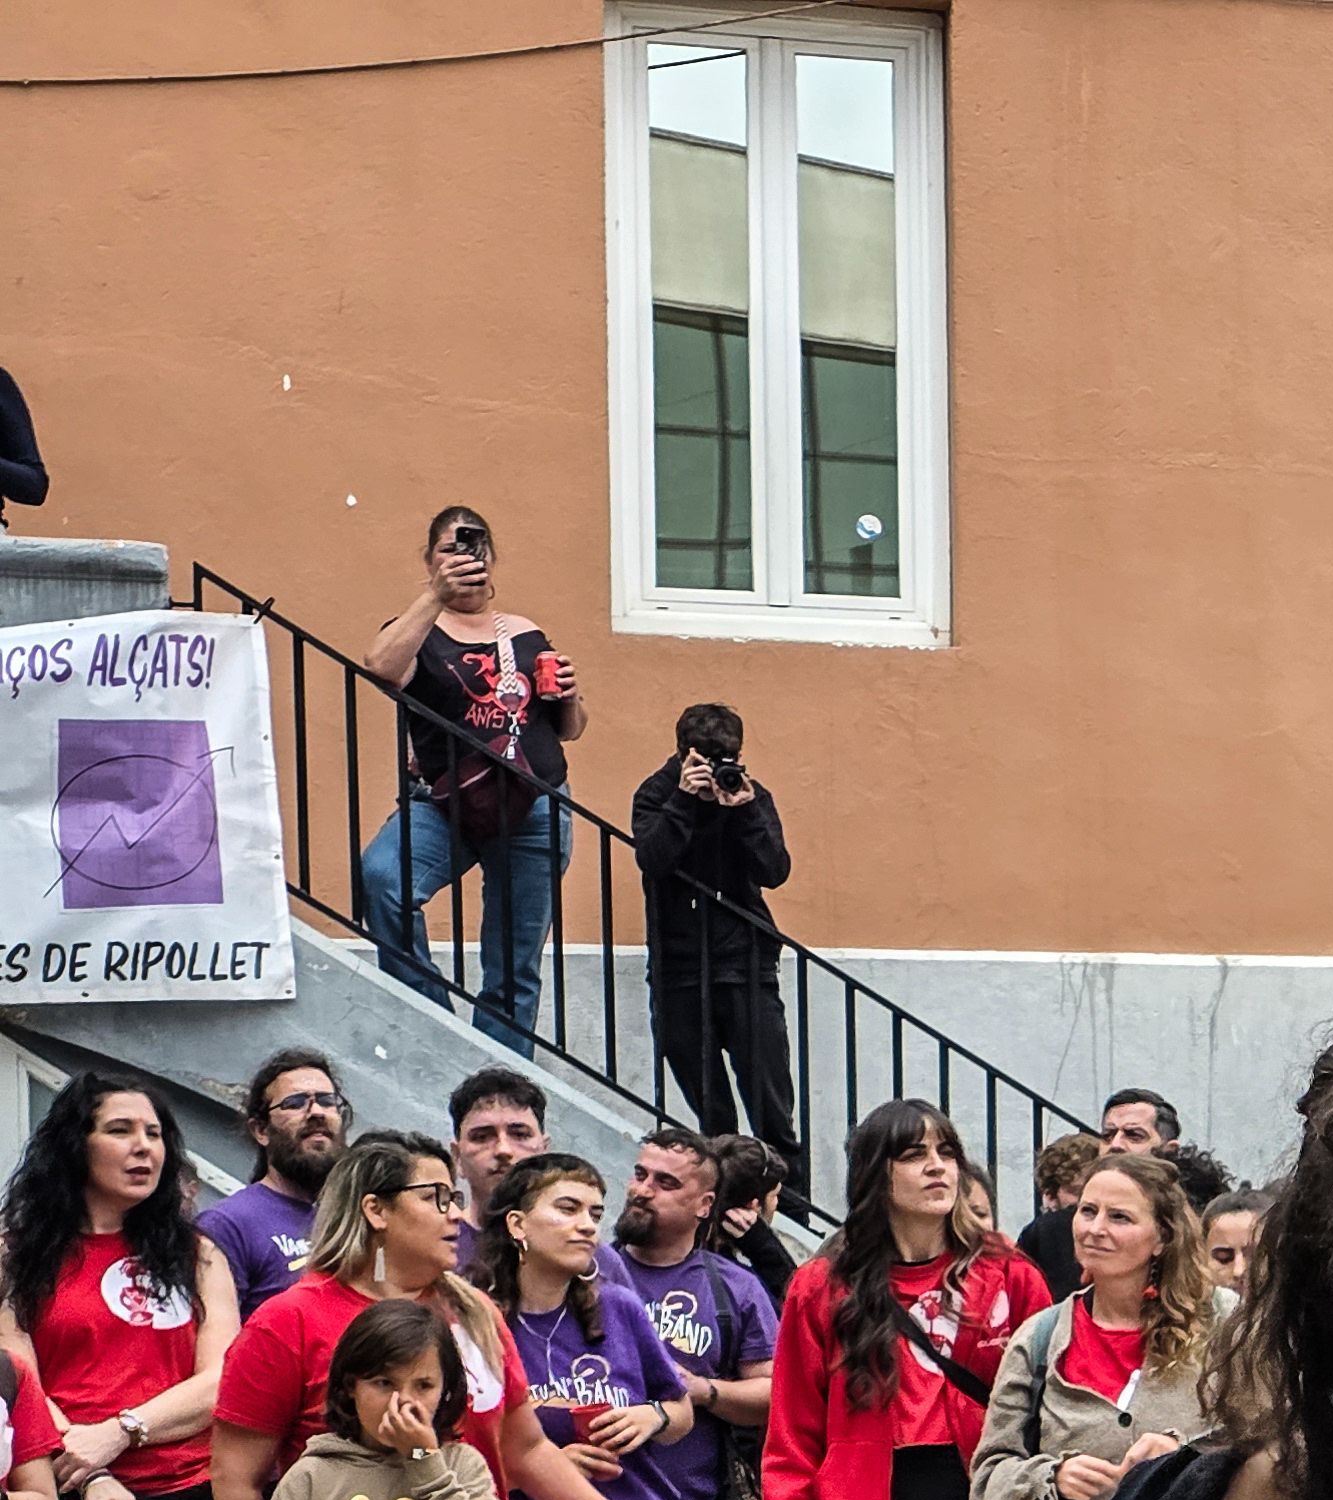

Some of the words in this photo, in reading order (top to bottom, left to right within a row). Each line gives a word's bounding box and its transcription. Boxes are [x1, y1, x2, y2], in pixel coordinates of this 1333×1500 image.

[0, 638, 73, 699] ÇOS
[87, 633, 216, 702] ALÇATS!
[42, 942, 92, 983] DE
[103, 941, 271, 983] RIPOLLET
